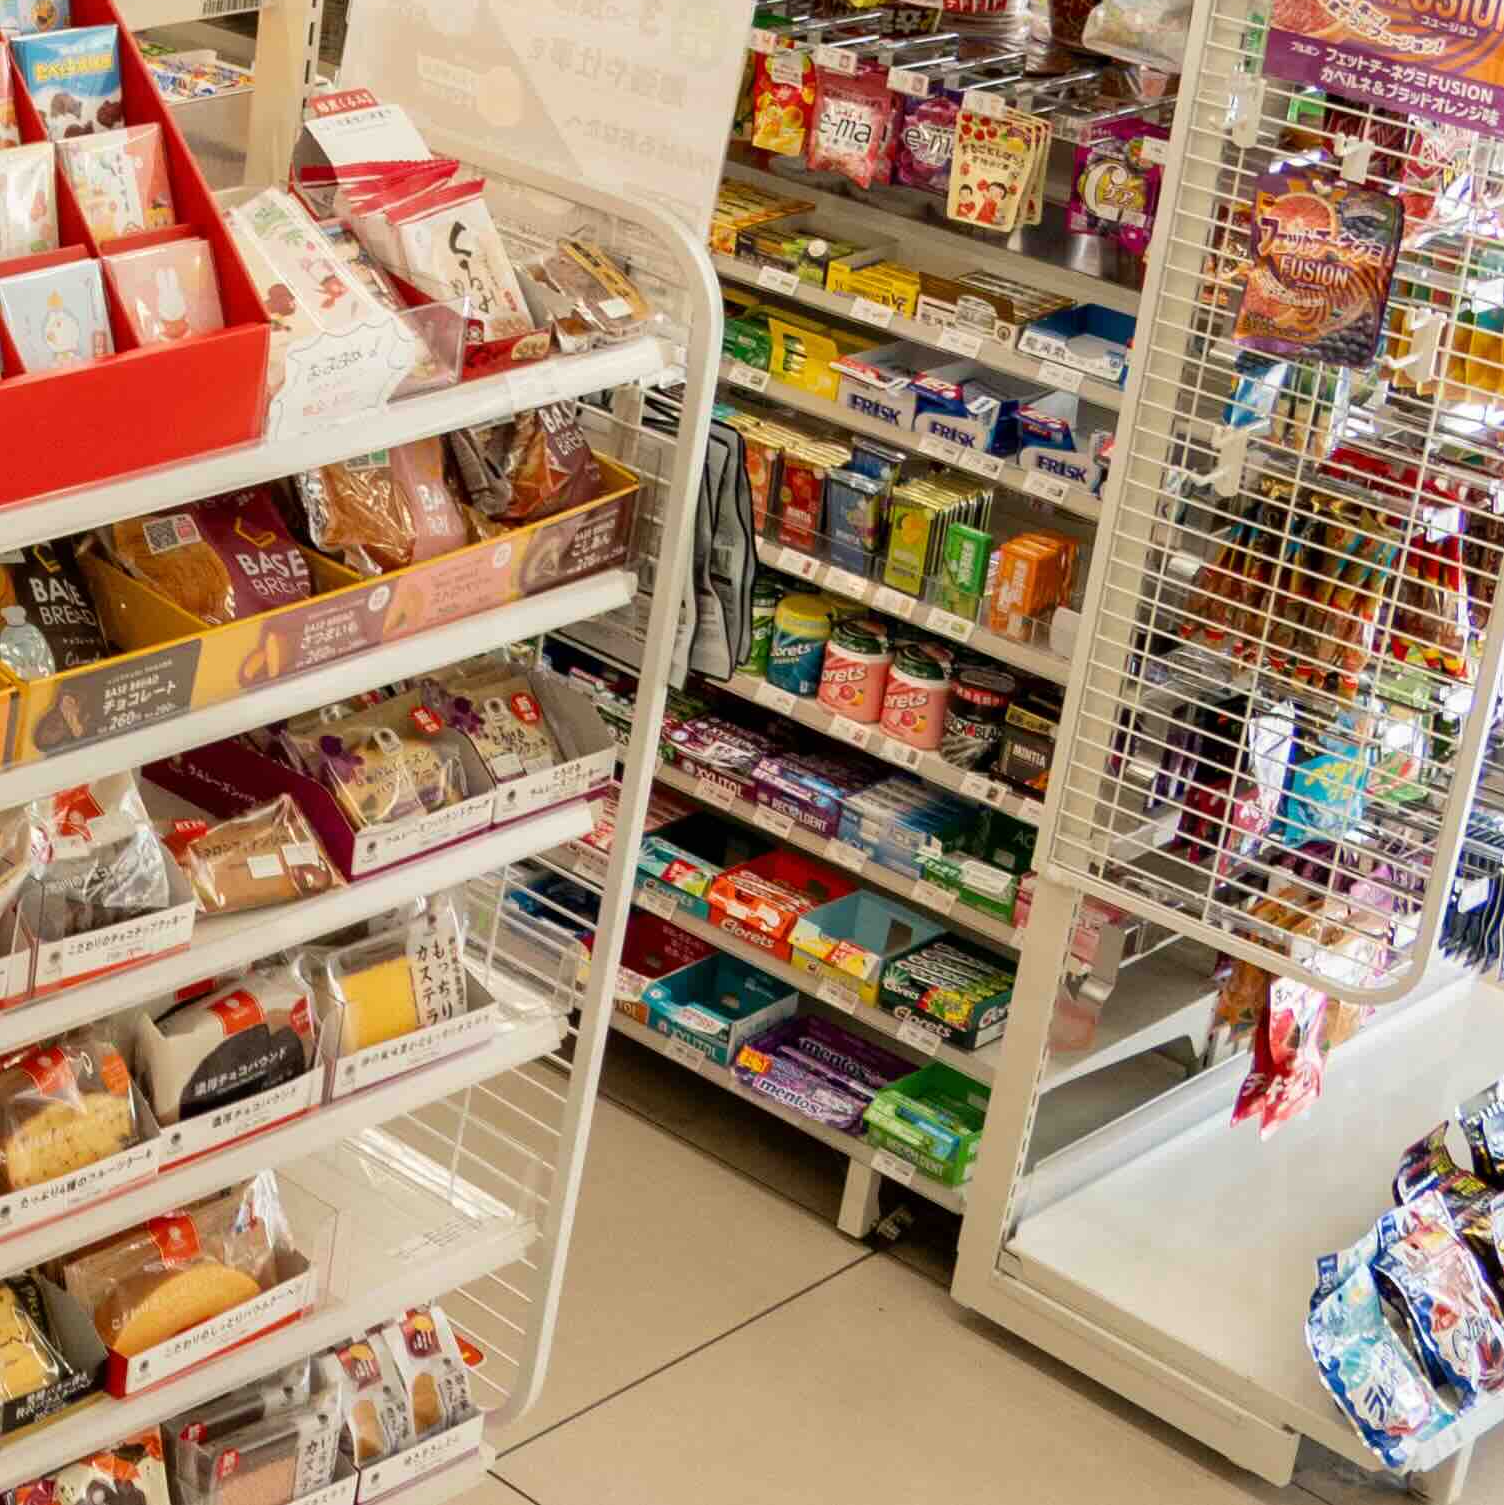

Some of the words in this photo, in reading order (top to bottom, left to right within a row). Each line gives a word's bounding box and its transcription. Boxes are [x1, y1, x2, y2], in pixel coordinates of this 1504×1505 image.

[1279, 255, 1349, 288] FUSION
[849, 392, 902, 427] FRISK
[930, 420, 976, 450] FRISK
[1036, 453, 1090, 484] FRISK
[237, 548, 308, 577] BASE
[103, 681, 177, 717] チョコレート
[694, 766, 744, 799] XYLITOL
[720, 916, 776, 949] Clorets
[416, 944, 440, 1025] カステラ
[433, 942, 453, 1022] もっちり
[894, 1004, 951, 1039] Clorets
[798, 1036, 867, 1080] mentos
[758, 1076, 820, 1114] mentos
